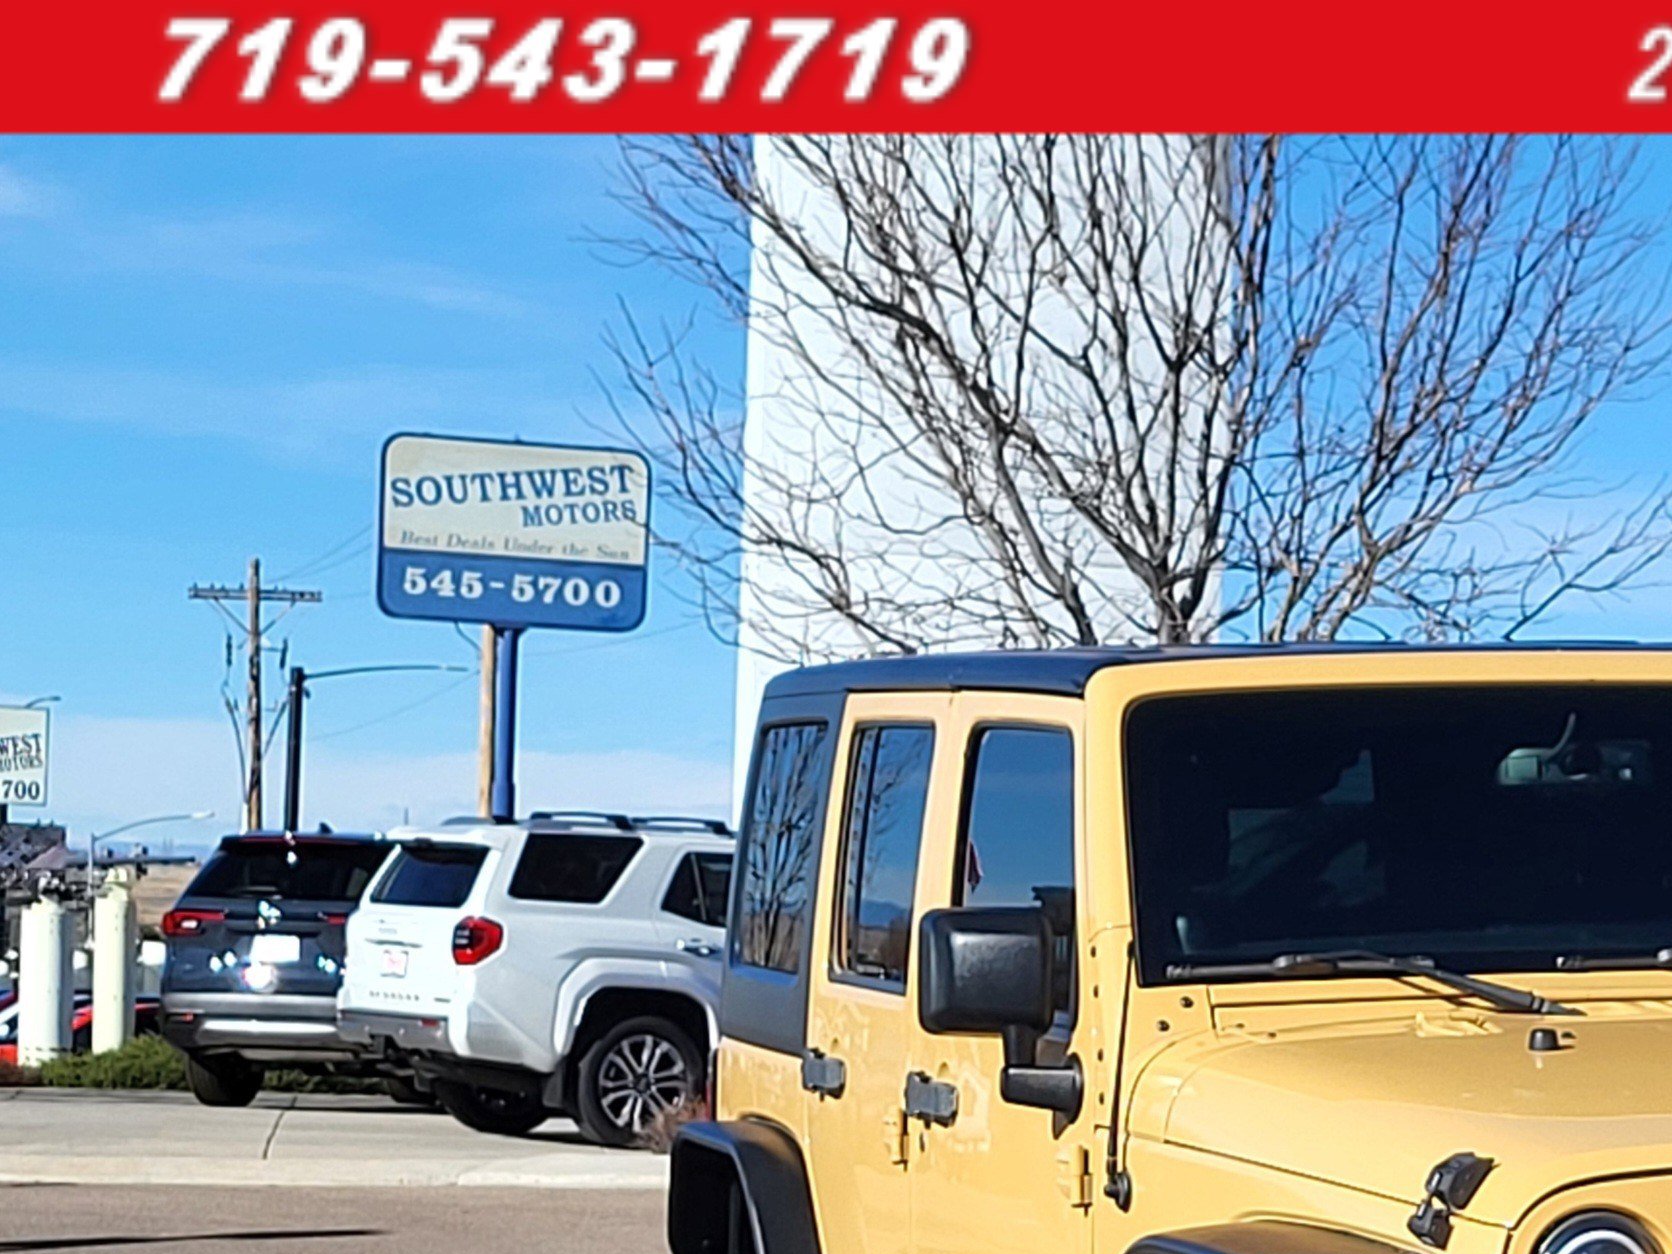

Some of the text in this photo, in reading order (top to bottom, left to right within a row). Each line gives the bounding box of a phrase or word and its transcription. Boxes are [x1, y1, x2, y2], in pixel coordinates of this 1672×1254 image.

[390, 464, 635, 508] SOUTHWEST
[522, 499, 637, 527] MOTORS
[400, 530, 630, 560] Best Deals Under the Sun
[403, 566, 621, 608] 545-5700
